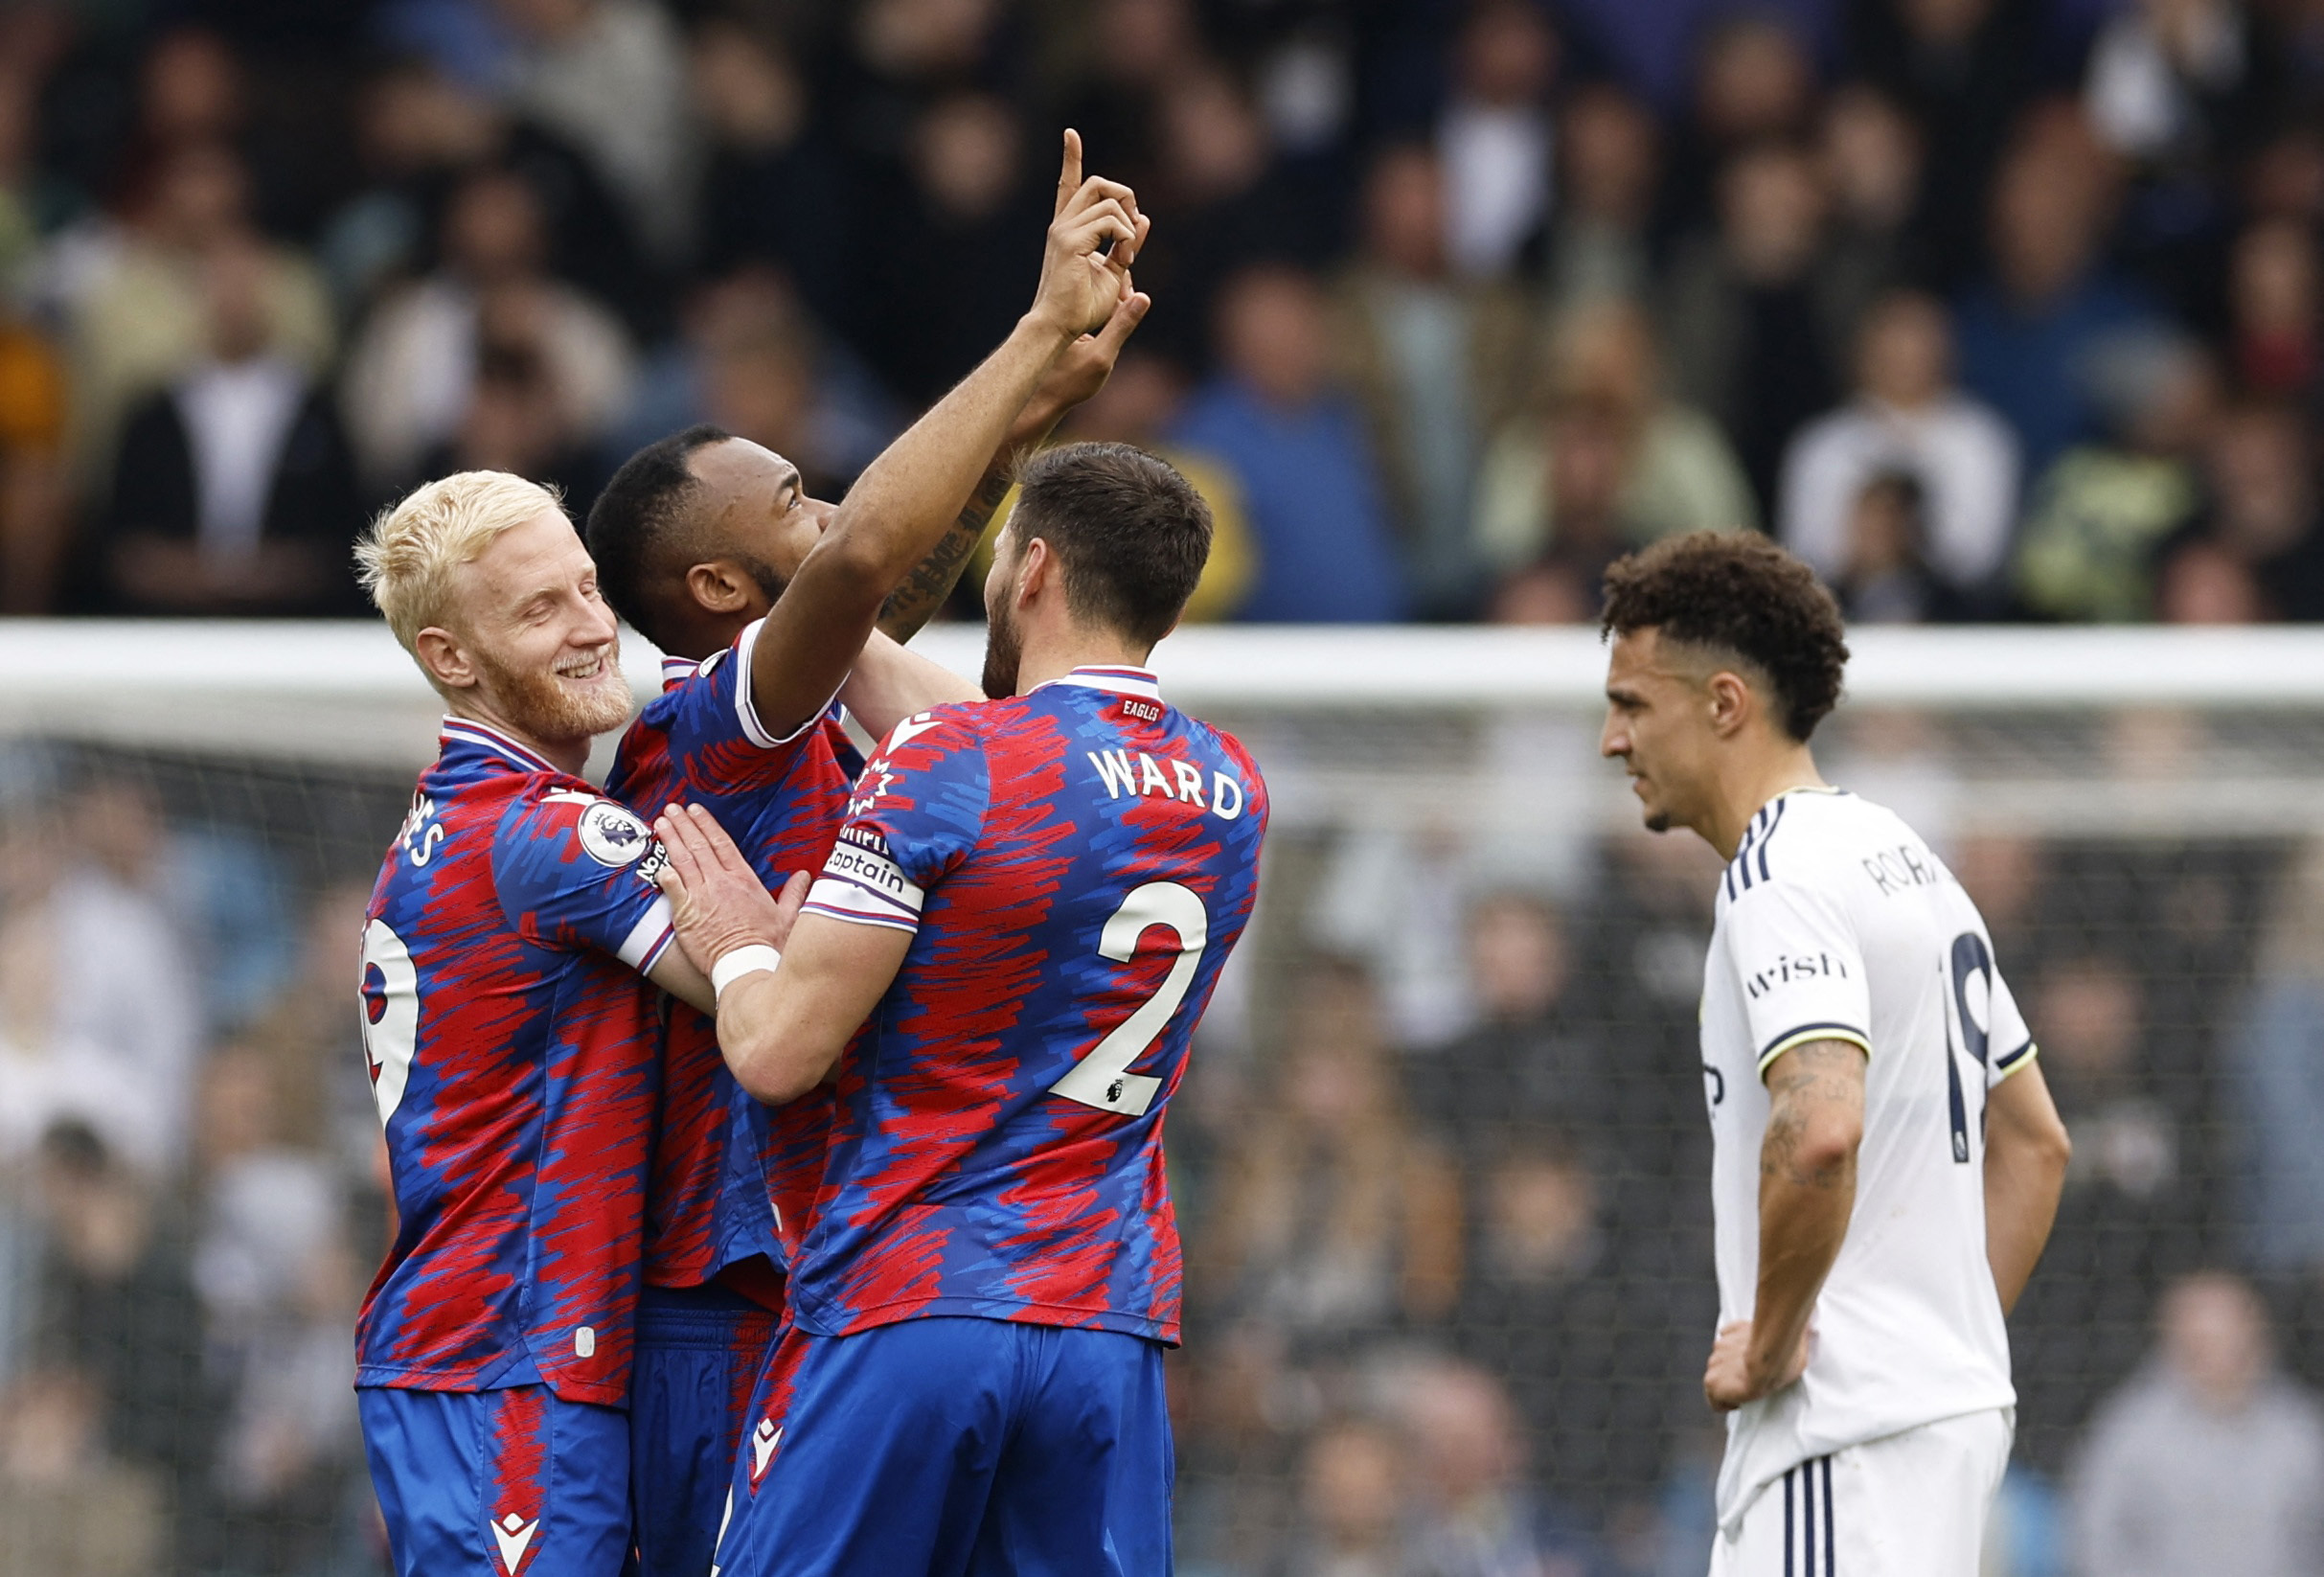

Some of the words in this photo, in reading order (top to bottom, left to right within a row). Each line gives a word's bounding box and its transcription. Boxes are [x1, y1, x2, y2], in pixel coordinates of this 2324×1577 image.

[1123, 699, 1160, 721] EAGLES
[1087, 748, 1243, 821] WARD
[828, 846, 904, 893] aptain
[1048, 880, 1209, 1117] 2
[1746, 950, 1848, 999] wish
[358, 917, 419, 1132] 9
[1938, 930, 1993, 1164] 19
